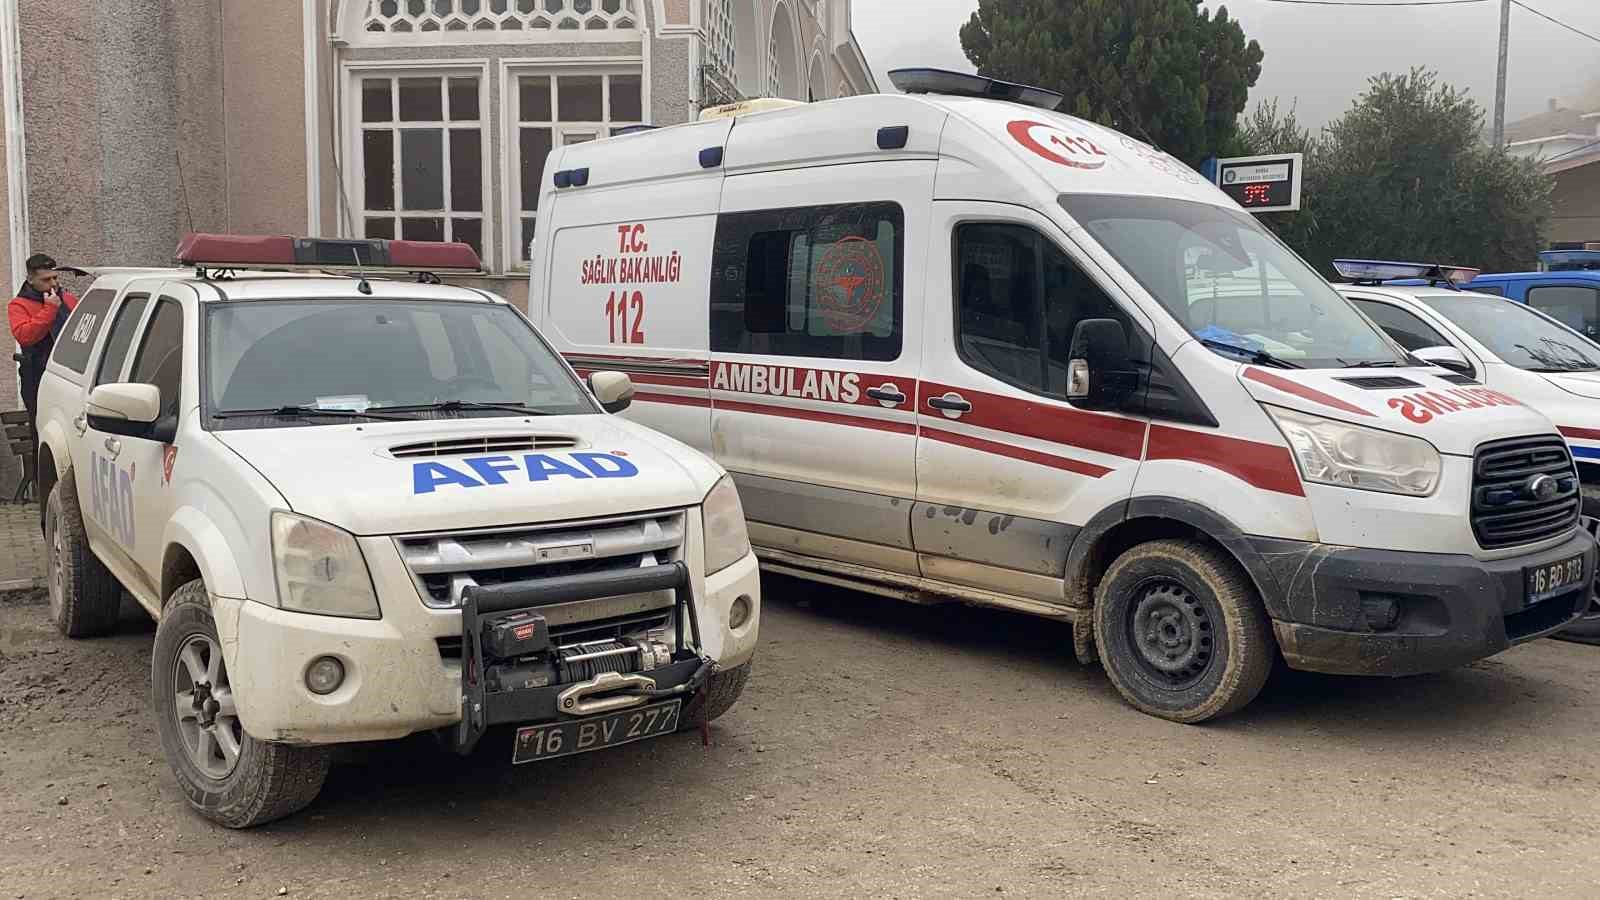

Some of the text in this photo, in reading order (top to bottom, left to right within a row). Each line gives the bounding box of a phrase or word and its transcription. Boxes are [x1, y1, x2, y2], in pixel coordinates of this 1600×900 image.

[1050, 135, 1108, 156] 112
[617, 223, 648, 253] T.C.
[581, 250, 682, 285] SAĞLIK BAKANLIĞI
[605, 290, 645, 344] 112
[713, 362, 861, 404] AMBULANS
[413, 453, 639, 495] AFAD
[1535, 568, 1546, 593] 16
[534, 705, 676, 755] 16 BV 277
